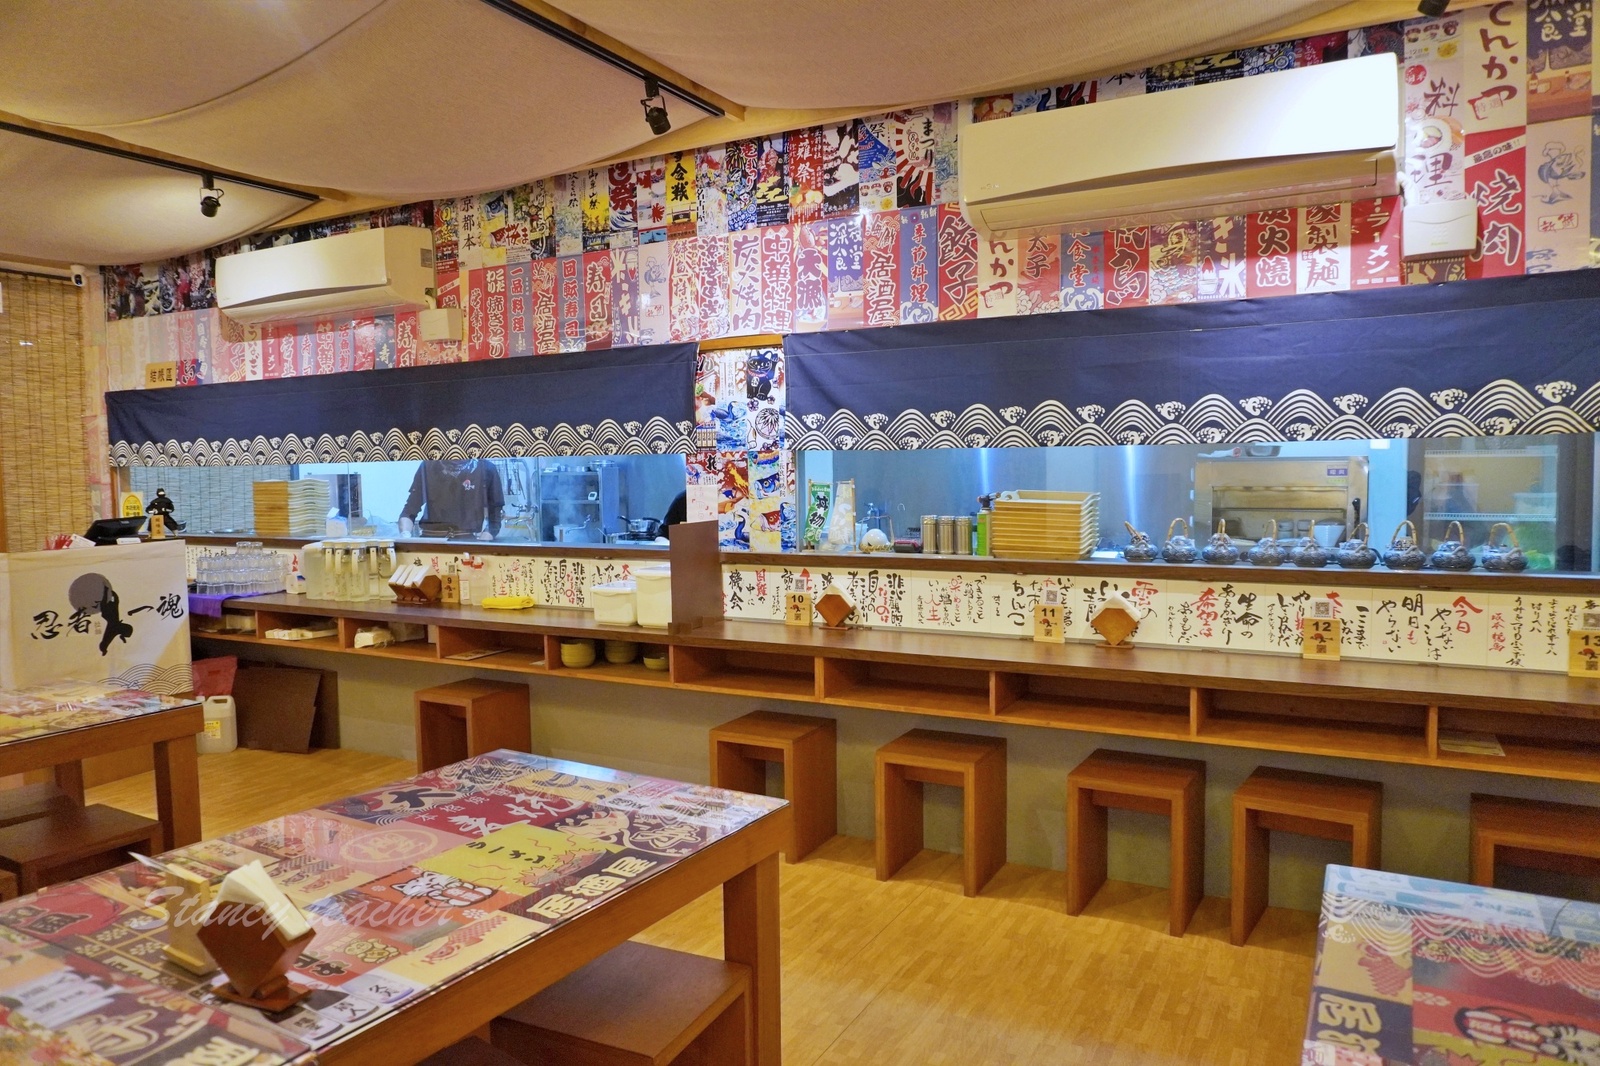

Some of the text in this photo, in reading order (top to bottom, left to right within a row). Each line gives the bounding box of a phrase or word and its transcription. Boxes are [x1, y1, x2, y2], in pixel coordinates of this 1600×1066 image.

[919, 117, 935, 167] まつり
[510, 266, 526, 333] 一品料理
[562, 258, 580, 339] 回転寿司
[586, 261, 607, 322] 寿司
[732, 234, 761, 332] 炭火焼肉
[762, 233, 793, 333] 中華料理
[866, 251, 896, 325] 居酒屋
[487, 295, 505, 359] 焼きとり
[535, 292, 557, 355] 居酒屋
[30, 592, 185, 640] 忍者 一魂
[791, 594, 804, 604] 10
[1041, 607, 1055, 617] 11
[1234, 591, 1263, 639] 生命の
[1401, 593, 1424, 645] 明日も
[1452, 595, 1483, 634] 今日
[1312, 621, 1332, 632] 12
[1376, 599, 1402, 653] やらない
[1430, 607, 1455, 650] やらない
